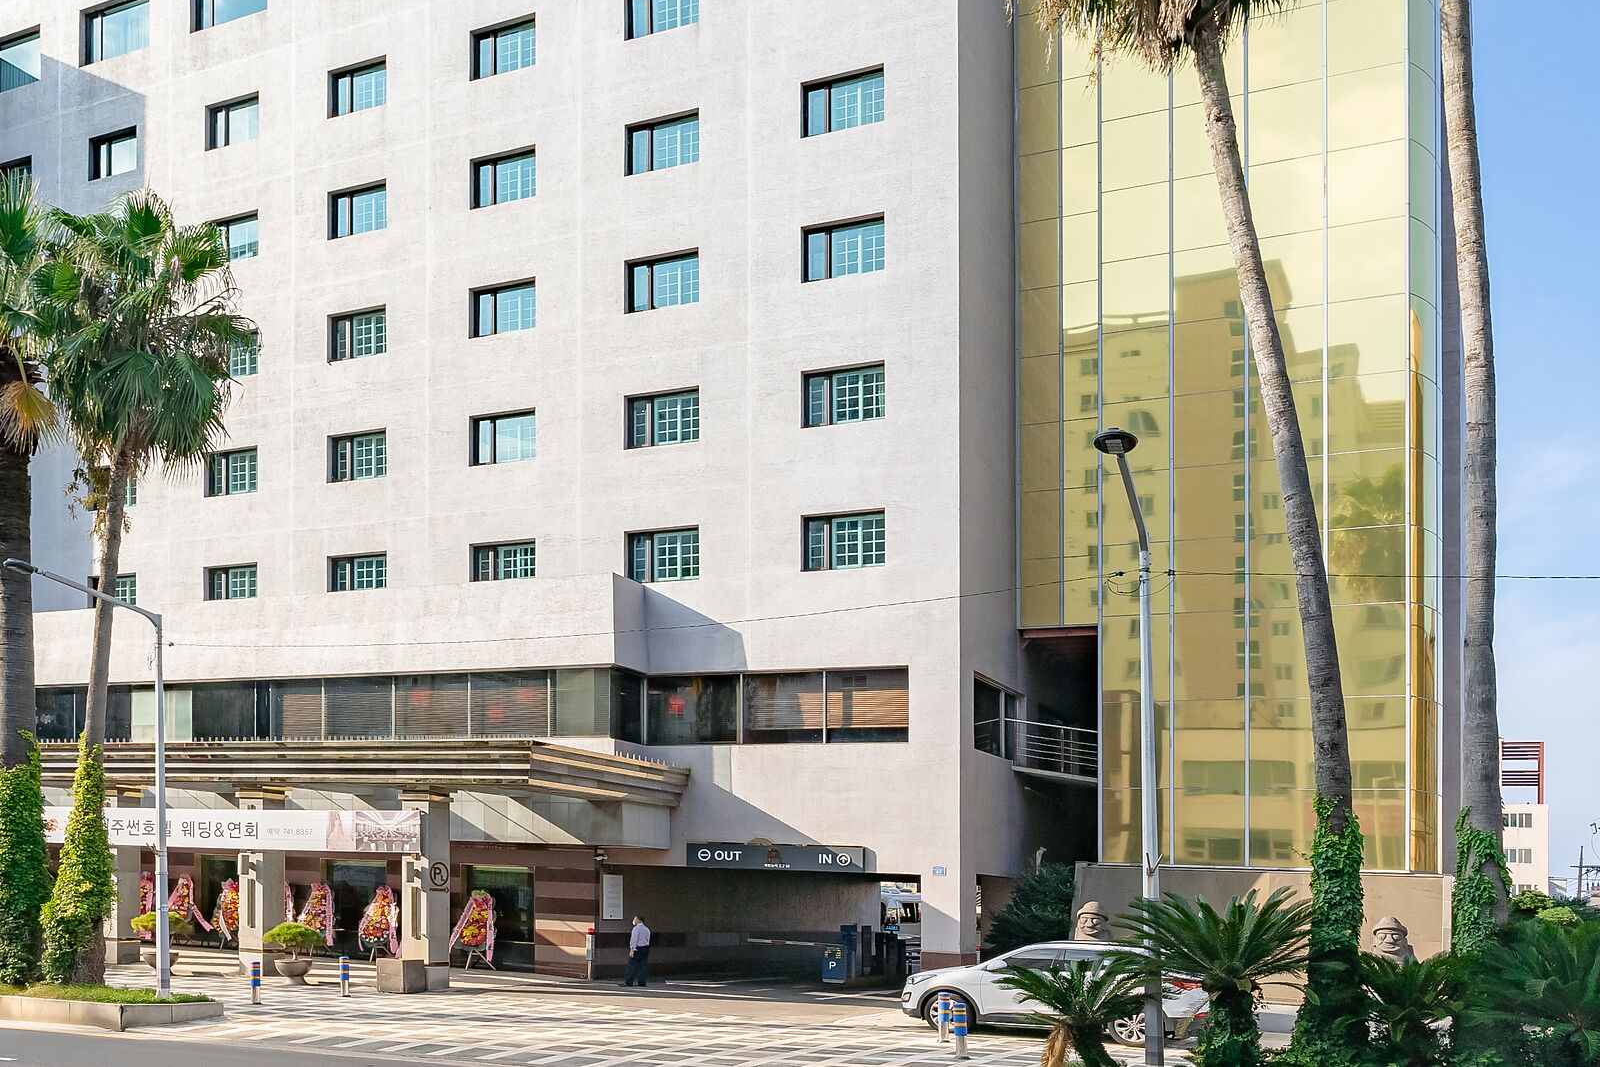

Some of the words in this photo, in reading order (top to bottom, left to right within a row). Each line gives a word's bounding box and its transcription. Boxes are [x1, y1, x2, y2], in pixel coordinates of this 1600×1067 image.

[181, 820, 259, 840] 웨딩&연회
[714, 850, 742, 861] OUT
[818, 853, 833, 864] IN
[829, 961, 837, 970] P
